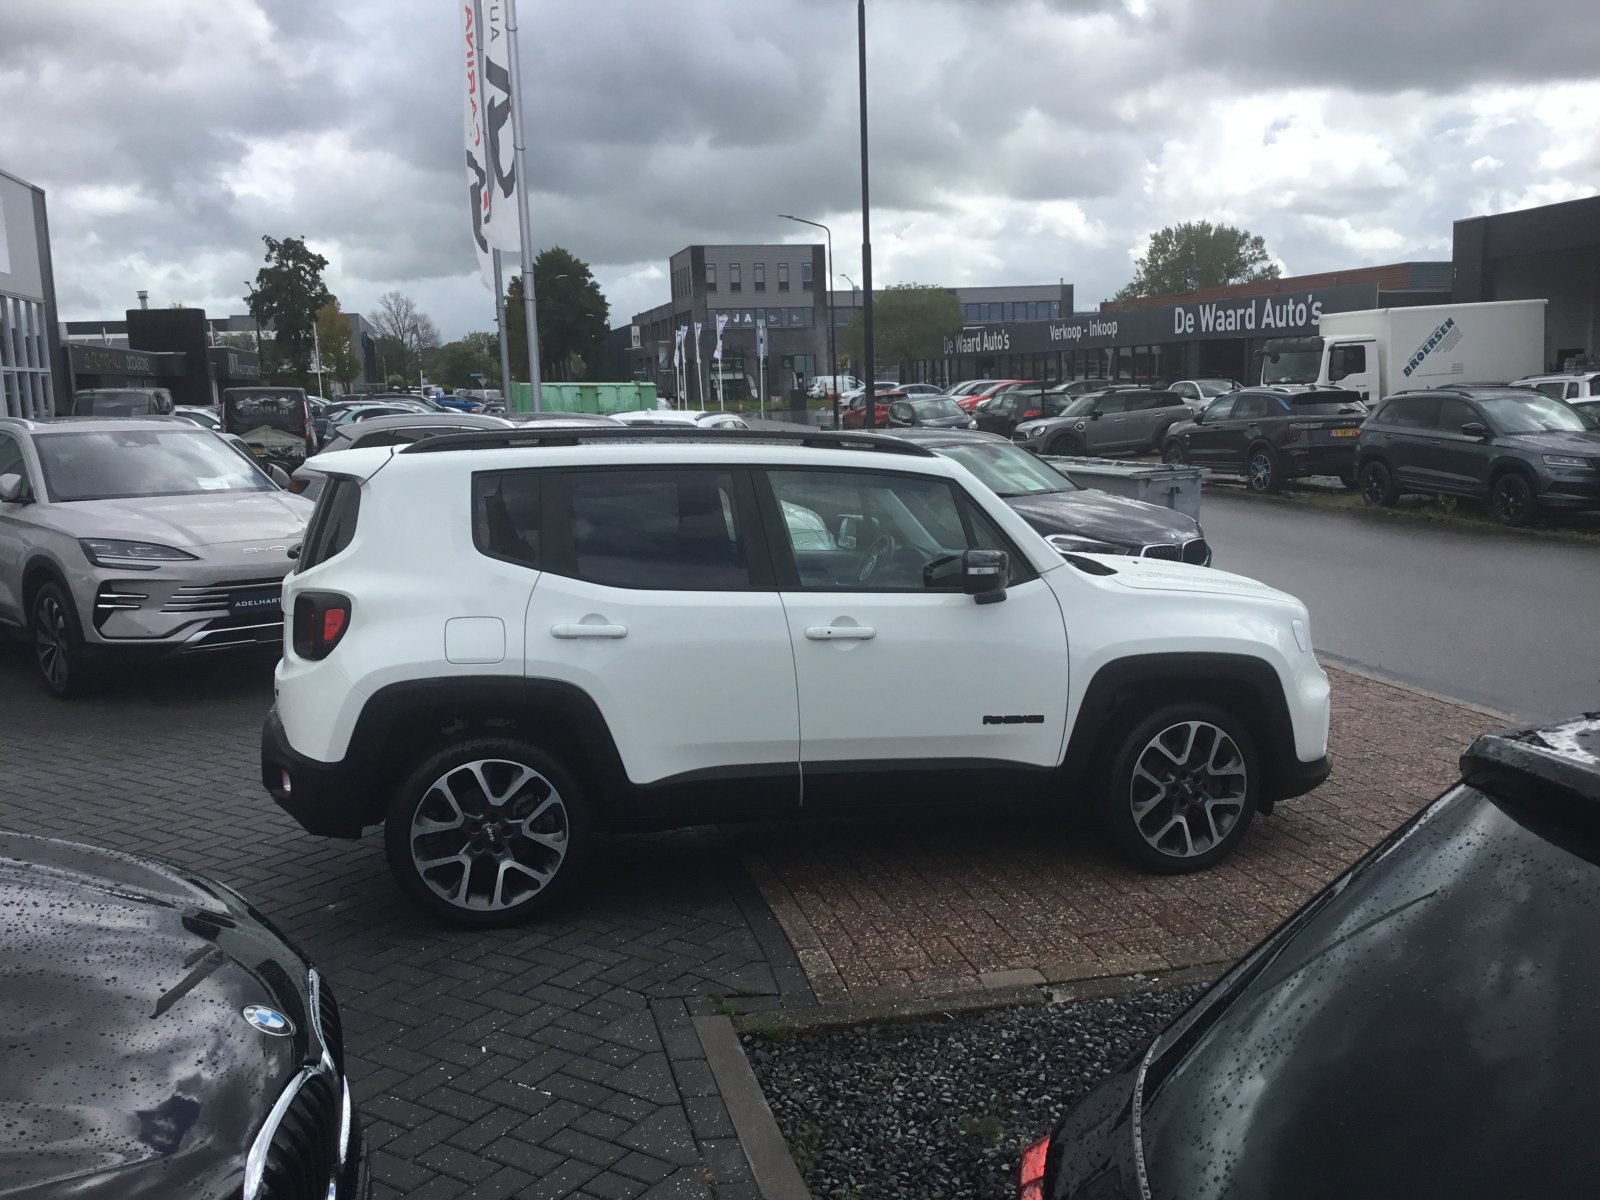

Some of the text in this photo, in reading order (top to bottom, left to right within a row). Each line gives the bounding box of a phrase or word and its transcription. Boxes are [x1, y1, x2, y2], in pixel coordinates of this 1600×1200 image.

[1174, 294, 1323, 334] De Waard Auto's
[943, 328, 1010, 355] De Waard Auto's
[1049, 323, 1082, 343] Verkoop
[1089, 319, 1118, 339] Inkoop
[1402, 317, 1455, 378] BROERSEN
